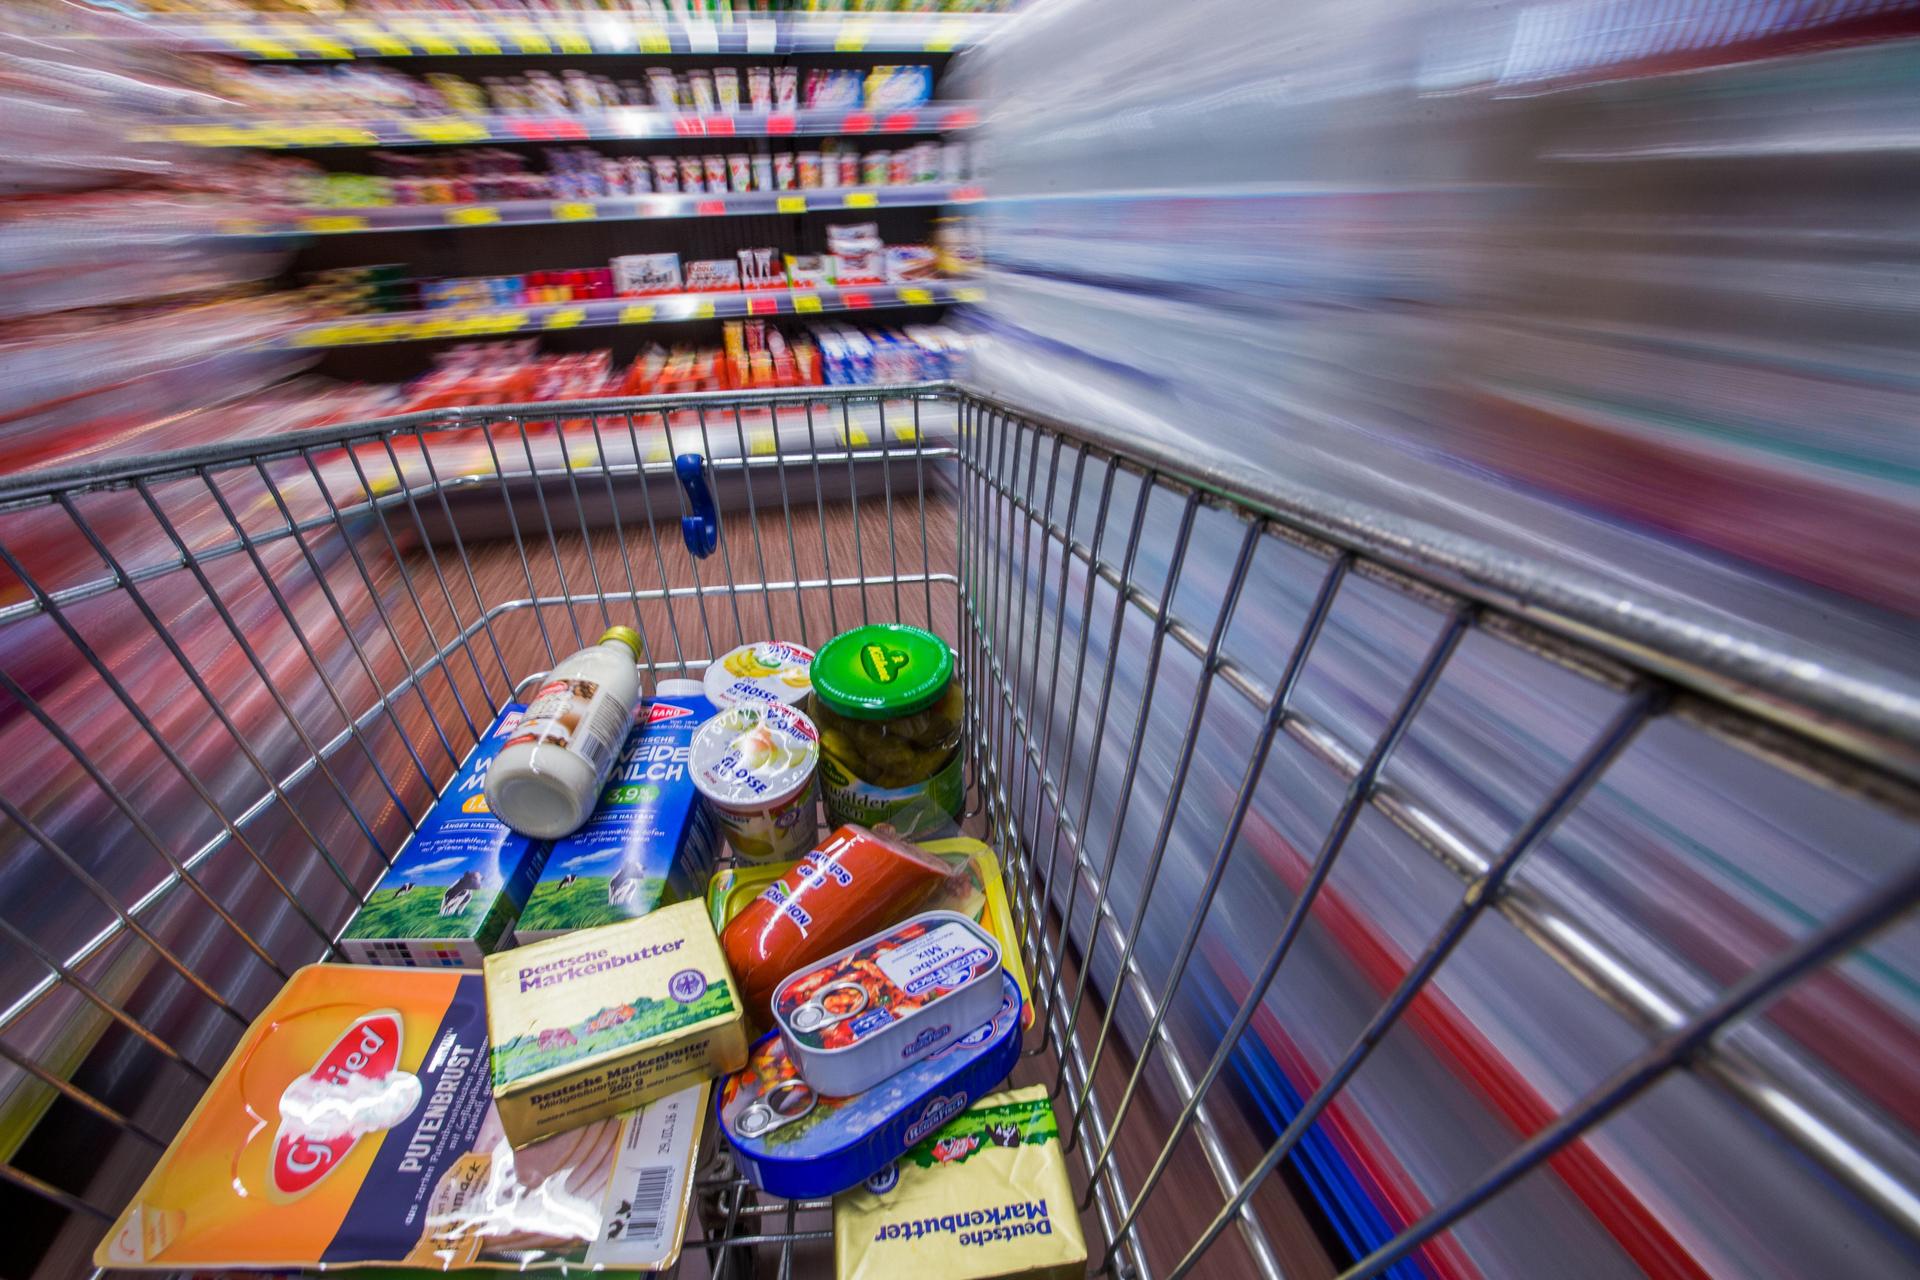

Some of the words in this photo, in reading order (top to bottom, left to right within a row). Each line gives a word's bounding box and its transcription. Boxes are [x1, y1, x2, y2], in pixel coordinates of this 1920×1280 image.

[518, 948, 609, 979] Deutsche
[519, 937, 686, 994] Markenbutter
[530, 1074, 603, 1106] Deutsche
[606, 1039, 711, 1085] Markenbutter
[397, 1044, 475, 1172] PUTENBRUST
[875, 1199, 1048, 1242] Markenbutter
[959, 1216, 1052, 1247] Deutsche
